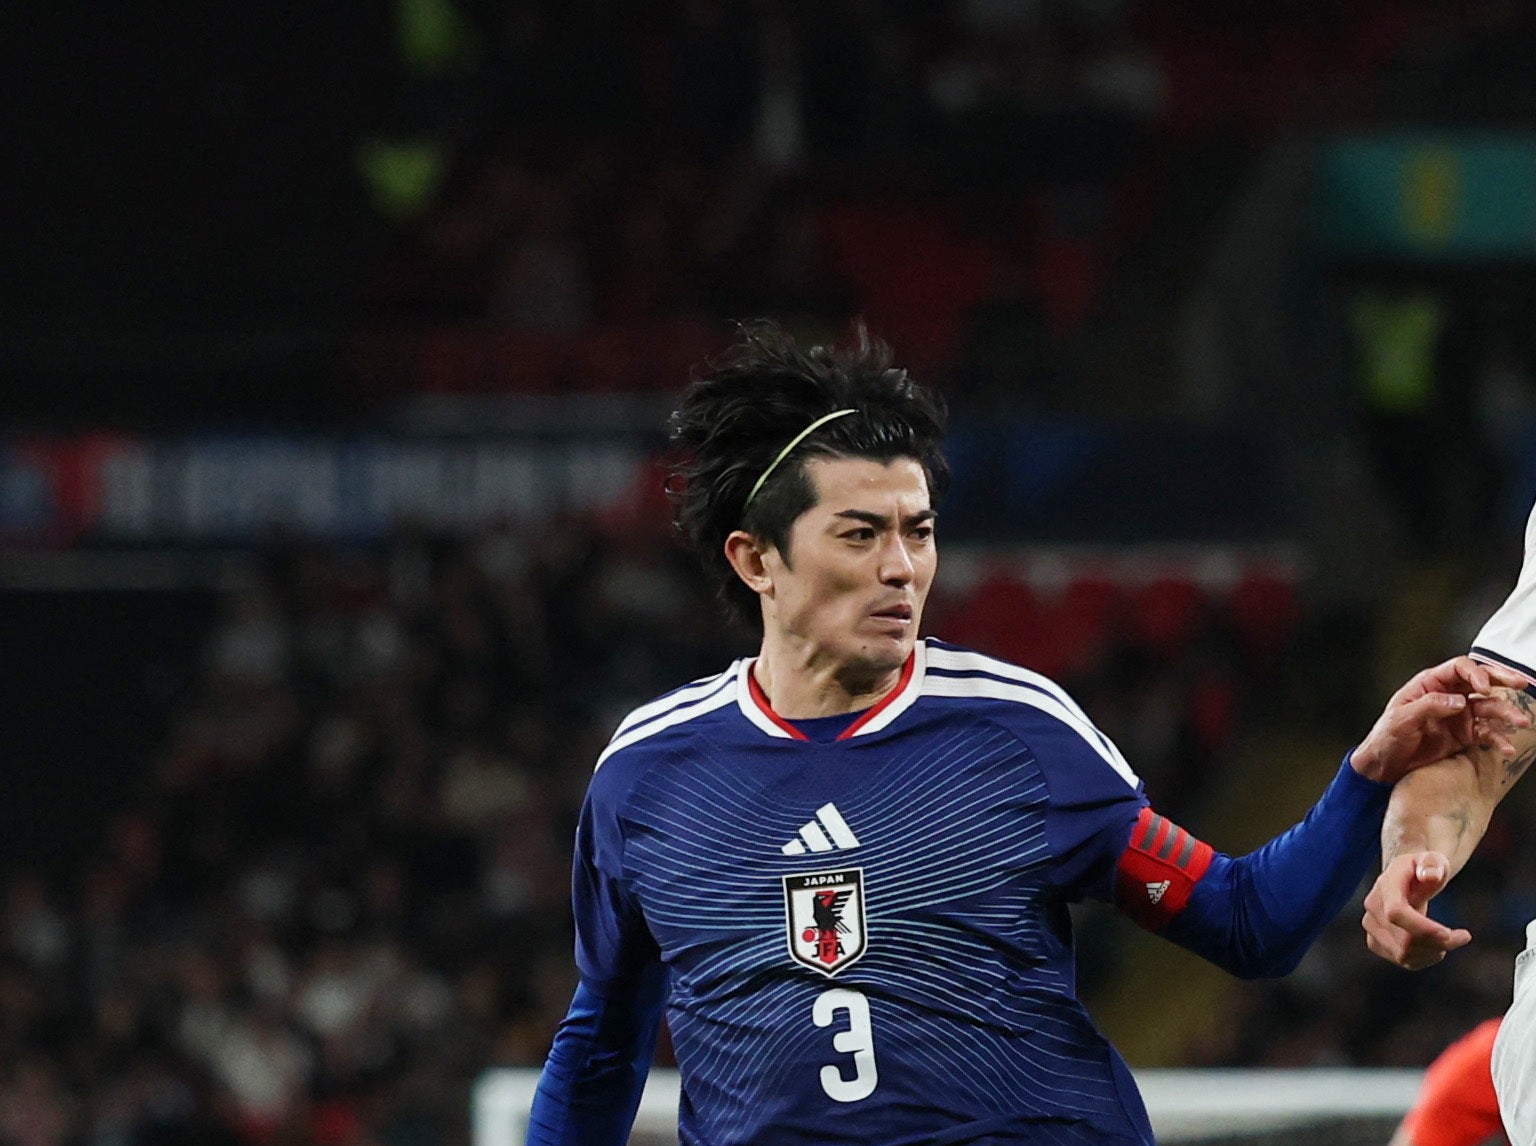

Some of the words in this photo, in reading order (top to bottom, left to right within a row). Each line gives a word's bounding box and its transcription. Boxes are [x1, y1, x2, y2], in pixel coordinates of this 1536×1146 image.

[803, 874, 844, 887] JAPAN
[811, 941, 846, 958] JFA
[812, 988, 878, 1102] 3
